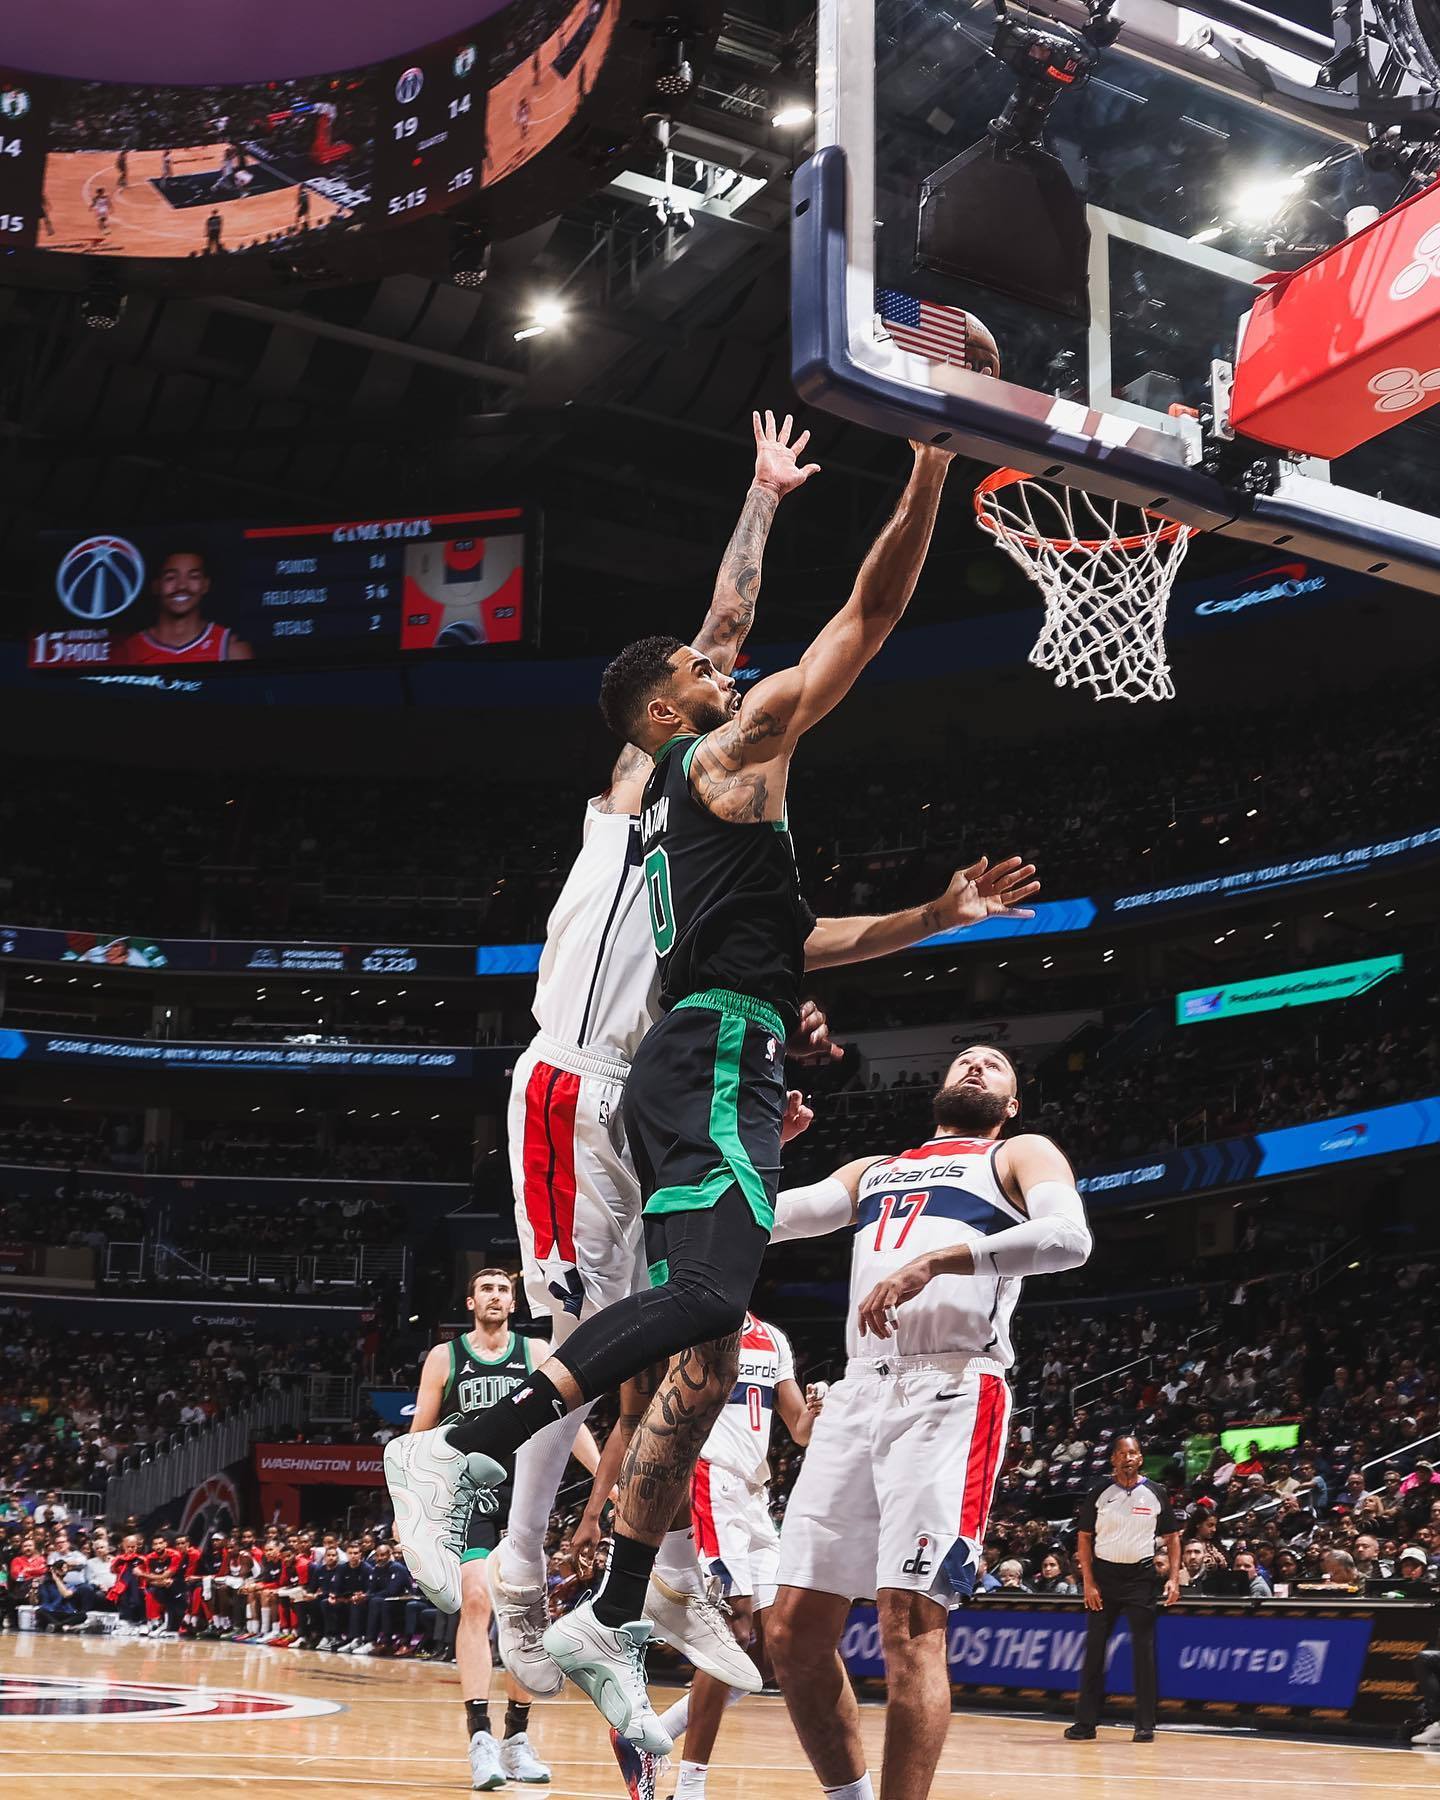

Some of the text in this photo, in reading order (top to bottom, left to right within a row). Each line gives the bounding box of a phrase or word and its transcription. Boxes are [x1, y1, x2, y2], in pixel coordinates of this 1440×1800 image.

[448, 93, 471, 119] 14
[393, 116, 418, 140] 19
[448, 167, 473, 192] :15
[388, 187, 427, 215] 5:15
[333, 520, 432, 542] GAME STATS
[33, 632, 65, 663] 15
[63, 642, 111, 662] POOLE
[1114, 892, 1154, 911] SCORE
[1153, 878, 1221, 903] DISCOUNTS
[1290, 853, 1344, 875] CAPITAL
[643, 844, 677, 958] 0
[866, 1160, 968, 1190] wizards
[1089, 1170, 1133, 1192] CREDIT
[1132, 1164, 1166, 1184] CARD
[872, 1191, 931, 1251] 17
[739, 1360, 777, 1379] zards
[458, 1375, 524, 1413] CELTIC
[747, 1386, 762, 1432] 0
[261, 1458, 384, 1472] WASHINGTON WIZ
[991, 1628, 1050, 1669] THE
[1049, 1630, 1132, 1672] WY
[1179, 1645, 1289, 1673] UNITED
